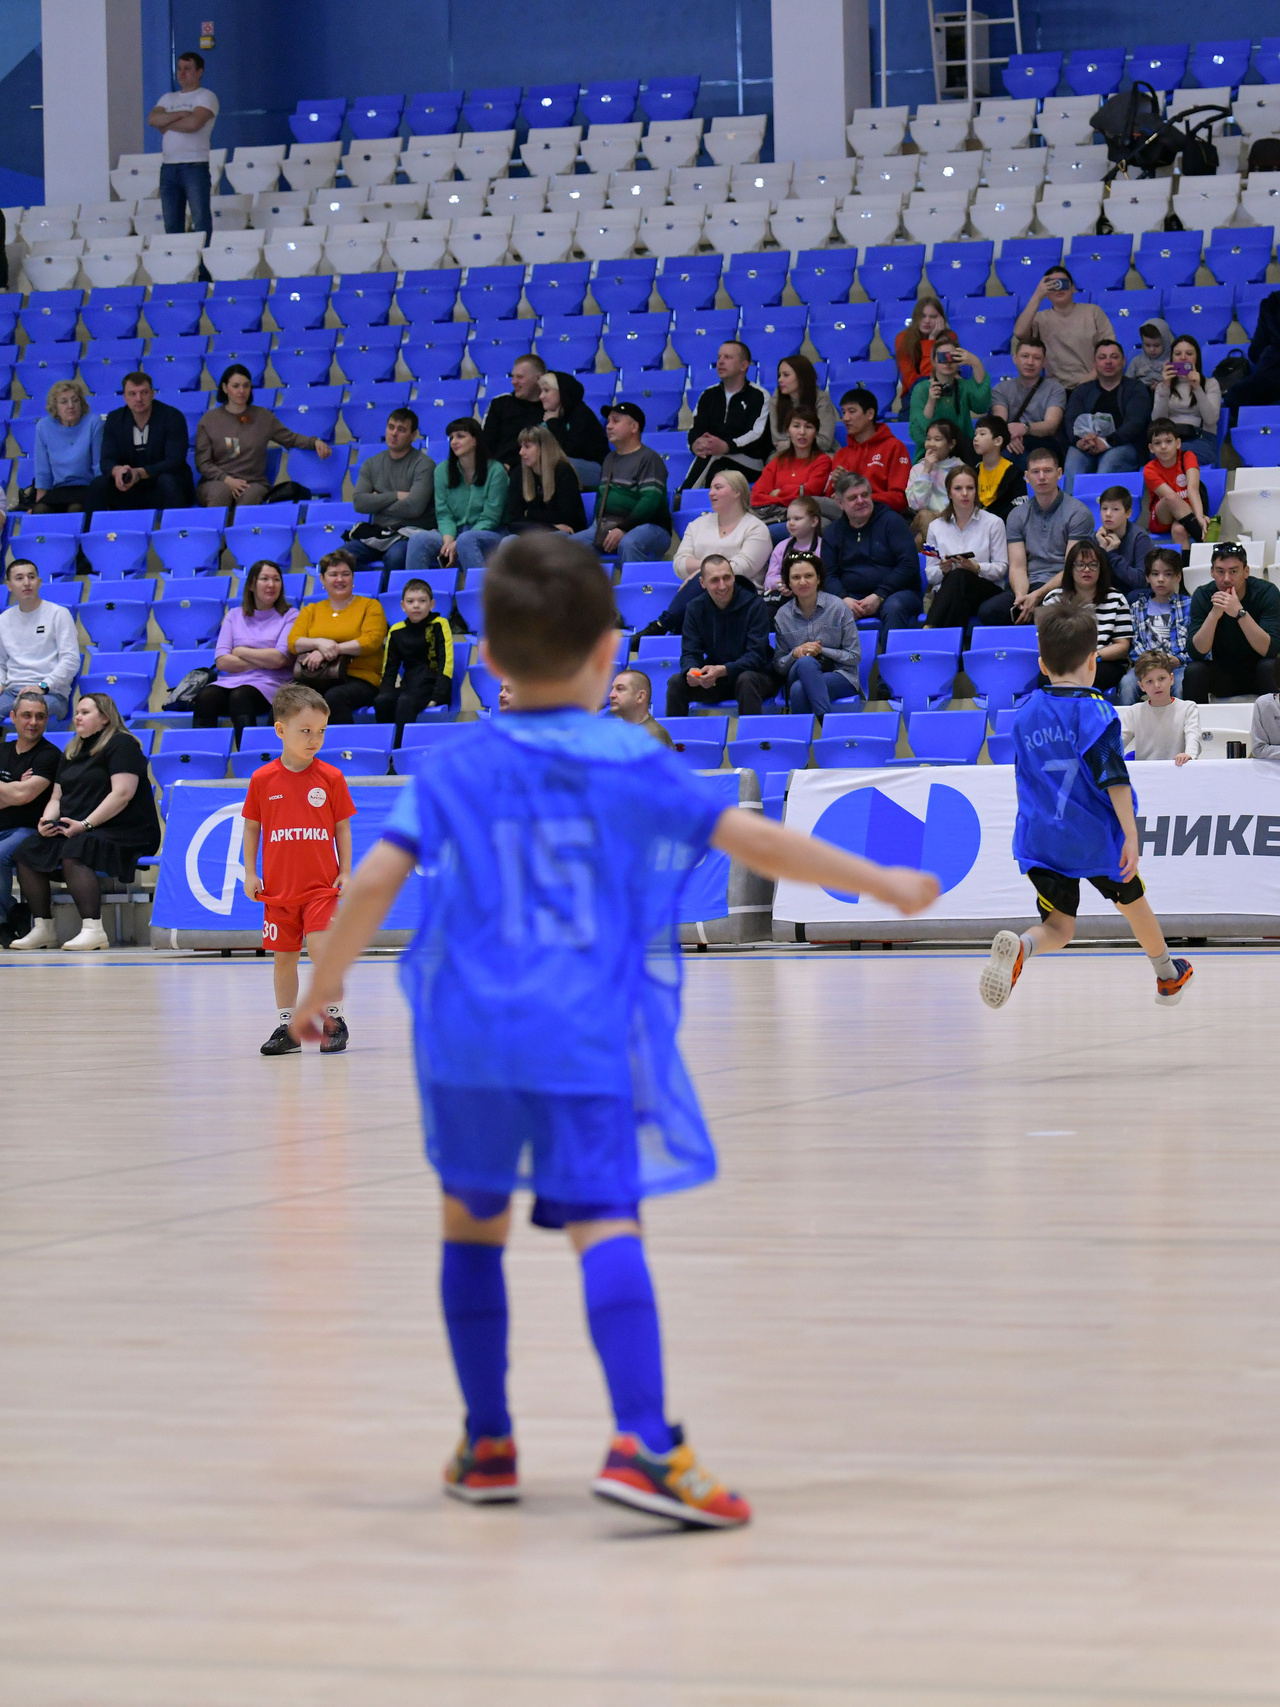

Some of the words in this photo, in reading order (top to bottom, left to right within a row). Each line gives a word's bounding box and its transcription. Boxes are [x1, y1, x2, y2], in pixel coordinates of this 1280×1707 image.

[1041, 758, 1080, 820] 7
[270, 827, 329, 843] АРКТИКА
[493, 818, 596, 946] 15
[262, 920, 278, 942] 30
